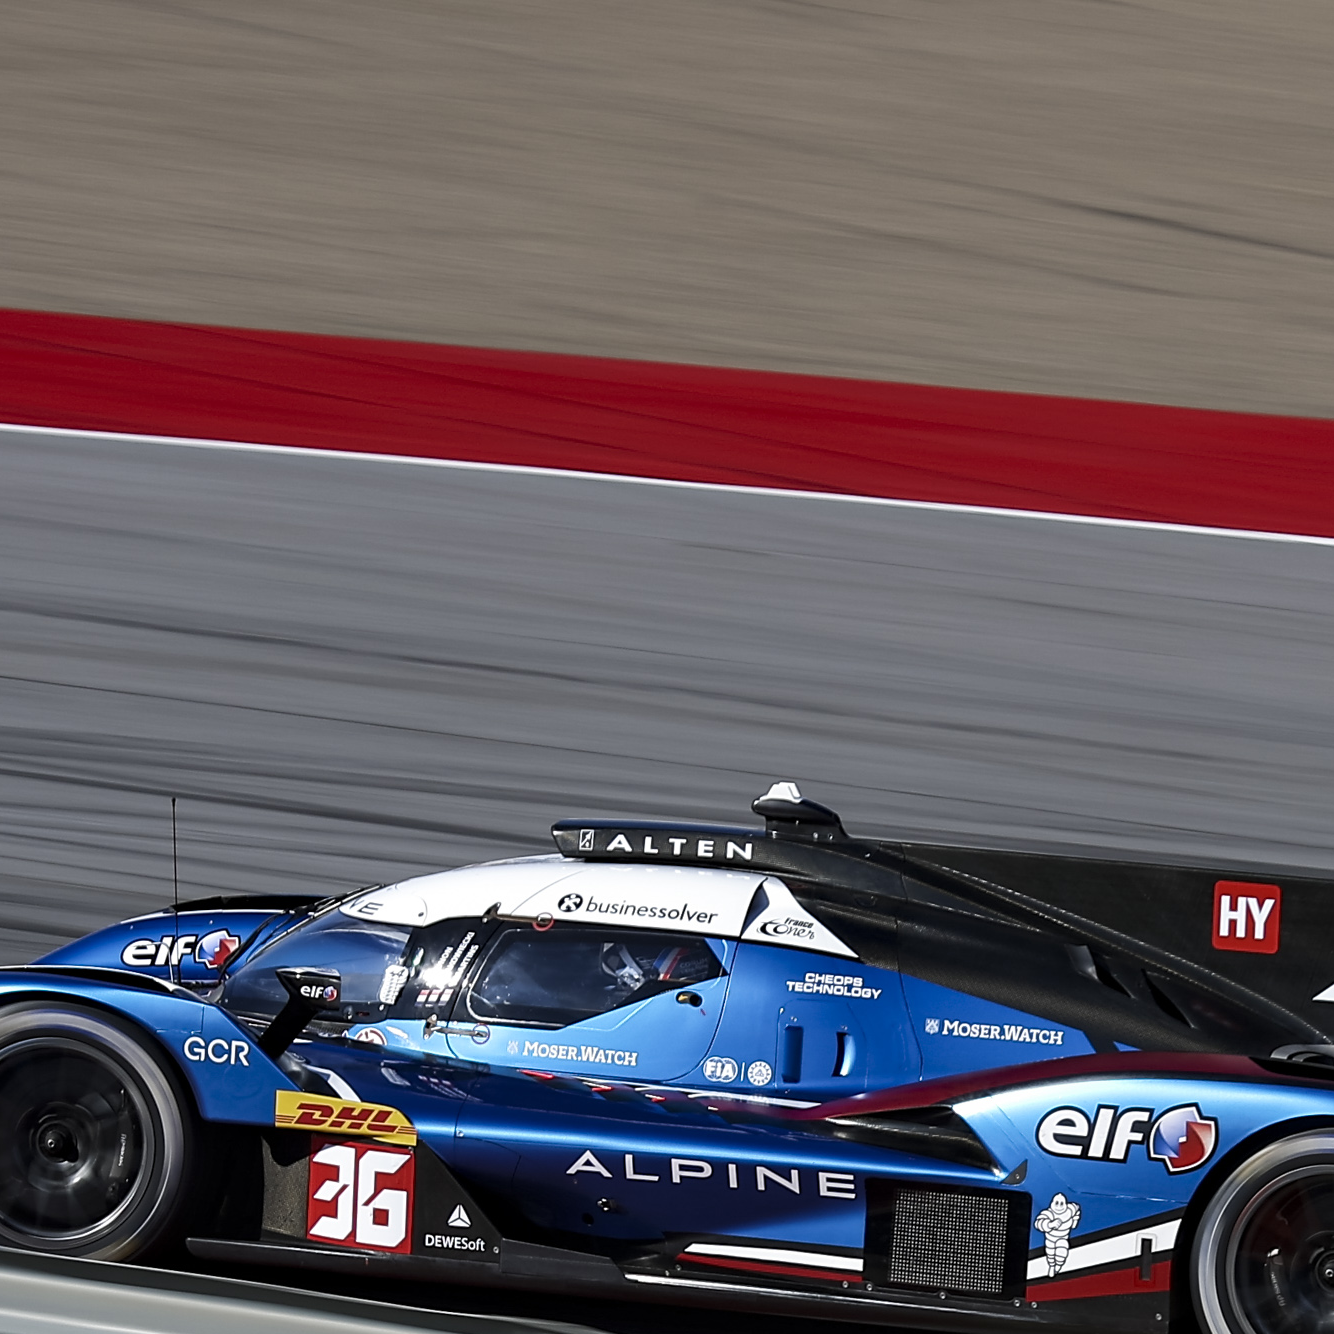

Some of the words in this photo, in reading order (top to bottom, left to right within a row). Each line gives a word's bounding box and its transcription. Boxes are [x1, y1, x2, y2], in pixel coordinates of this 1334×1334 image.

[607, 834, 753, 860] ALTEN
[586, 896, 718, 924] businessolver
[1219, 895, 1275, 939] HY
[123, 936, 196, 966] elf
[300, 985, 324, 998] elf
[786, 981, 881, 999] TECHNOLOGY
[805, 973, 863, 987] CHEOPS
[942, 1020, 1064, 1045] MOSER.WATCH
[184, 1036, 249, 1067] GCR
[522, 1041, 638, 1066] MOSER.WATCH
[706, 1061, 735, 1078] FIA
[294, 1102, 398, 1133] DHL
[1039, 1108, 1150, 1160] elf
[566, 1150, 856, 1199] ALPINE
[309, 1145, 411, 1247] 36
[425, 1234, 485, 1252] DEWESoft
